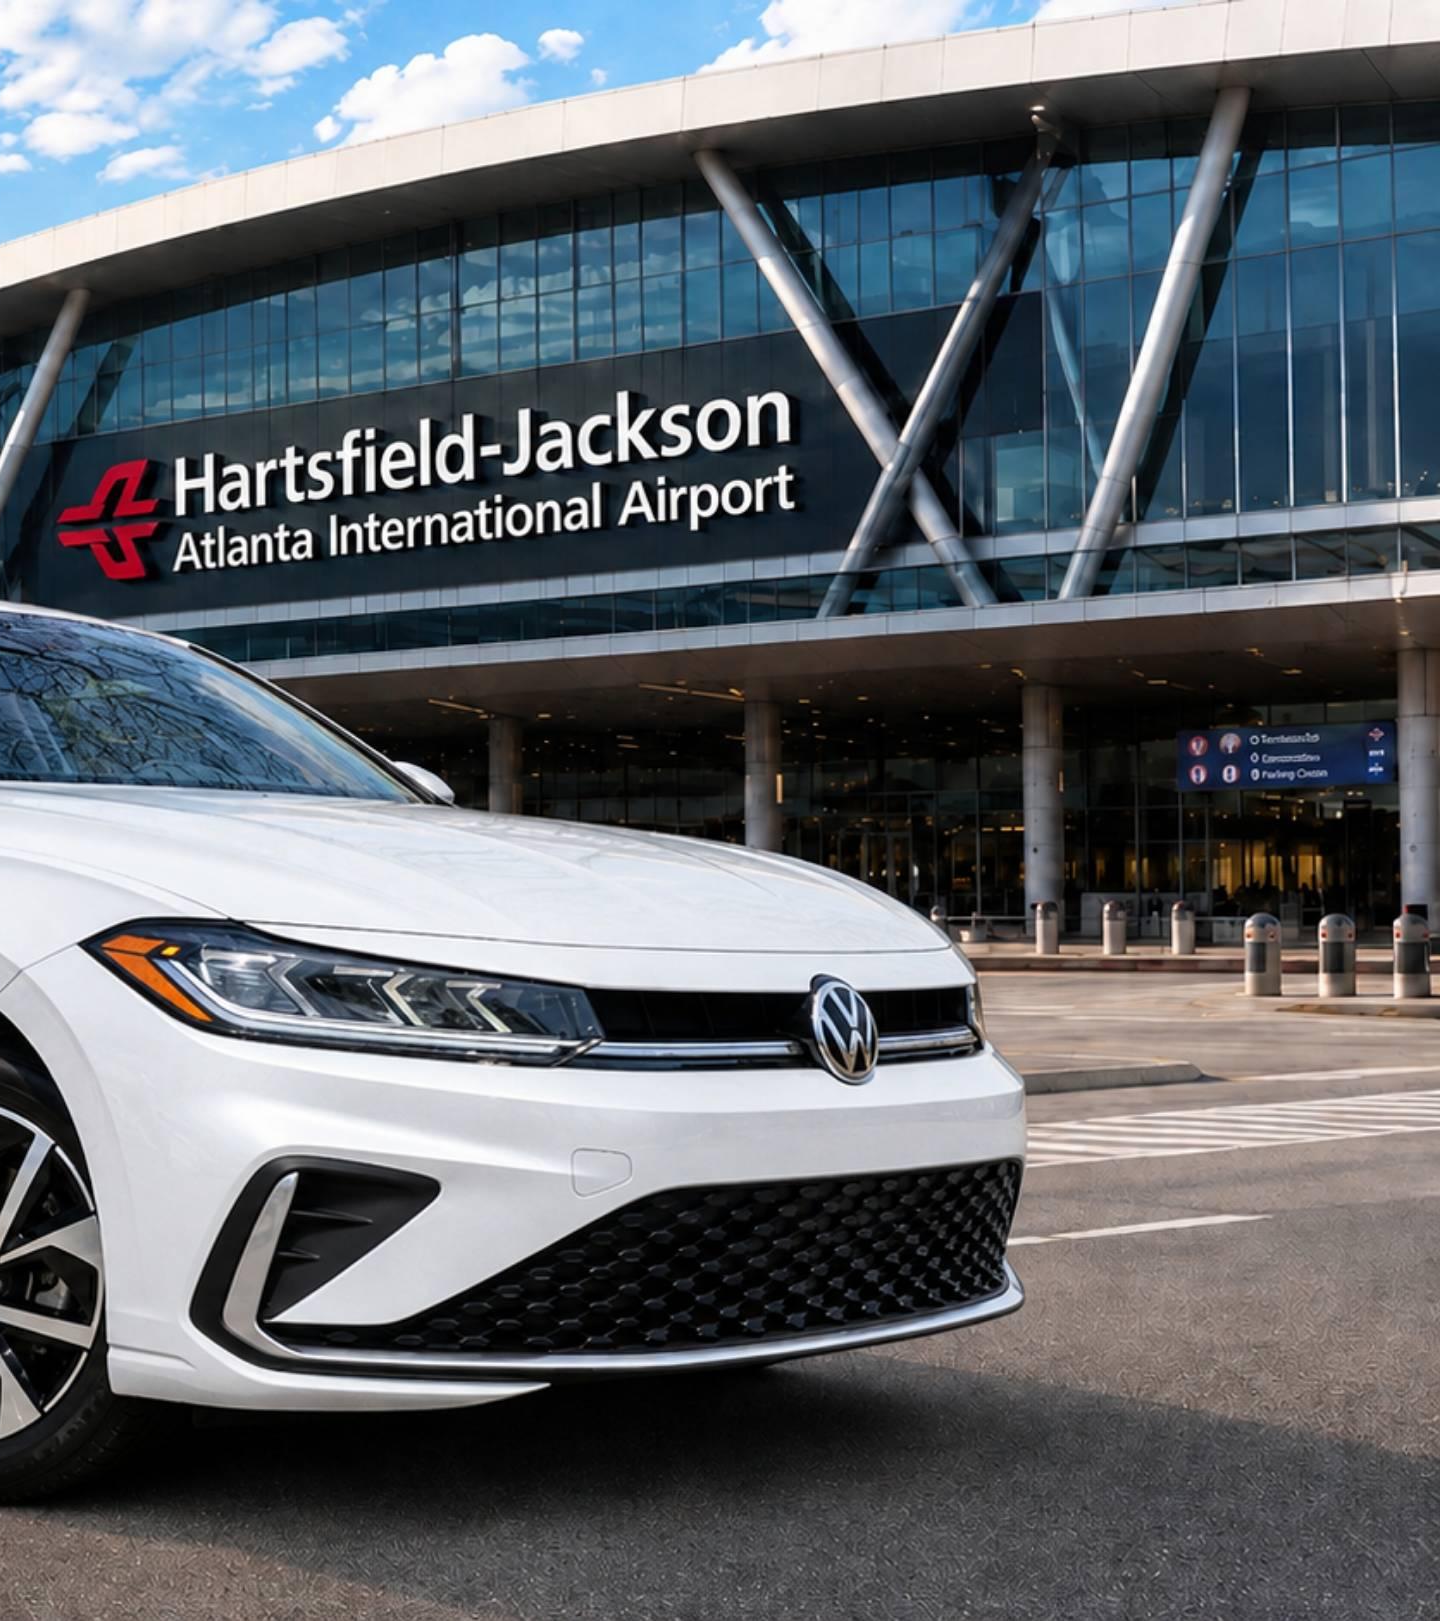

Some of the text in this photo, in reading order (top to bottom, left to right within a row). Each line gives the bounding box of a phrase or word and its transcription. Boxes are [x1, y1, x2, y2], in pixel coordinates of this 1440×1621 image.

[174, 389, 791, 517] Hartsfield-Jackson
[172, 464, 796, 573] Atlanta International Airport
[813, 981, 879, 1079] VW
